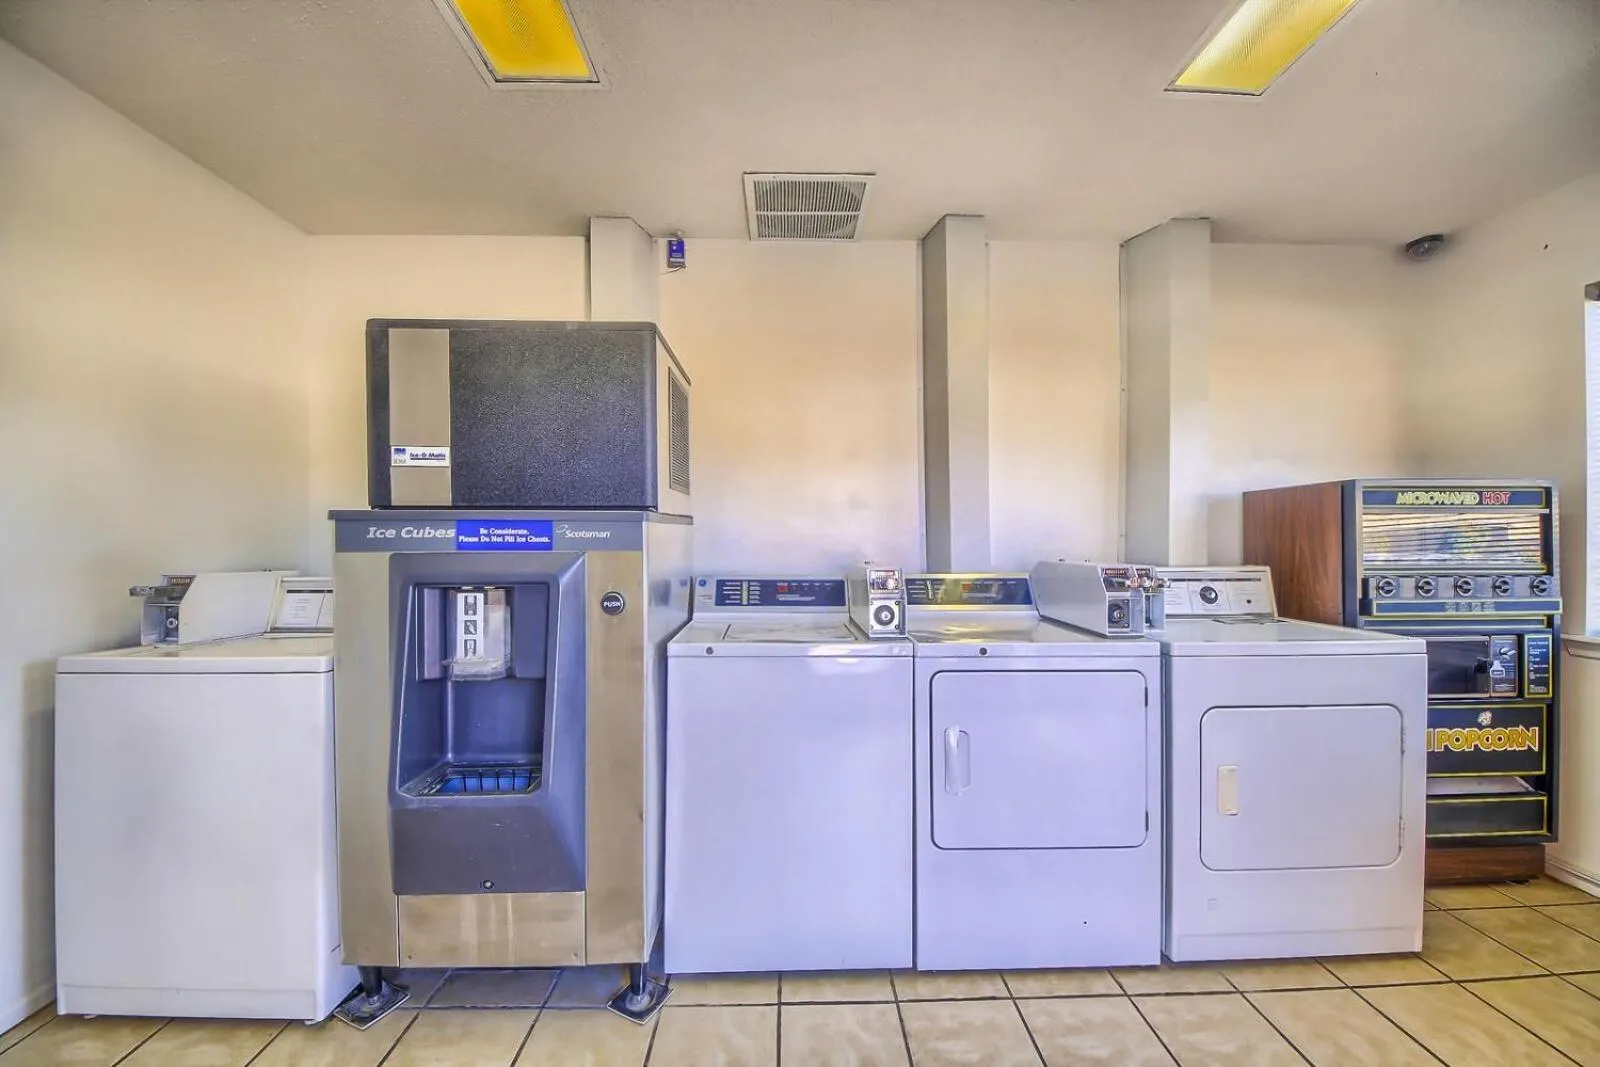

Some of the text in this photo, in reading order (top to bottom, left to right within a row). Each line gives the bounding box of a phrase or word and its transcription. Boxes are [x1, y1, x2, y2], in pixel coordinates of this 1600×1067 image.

[1396, 491, 1511, 505] MICROWAVED HOT
[366, 526, 457, 538] Ice Cubes
[565, 530, 611, 539] Scotsman
[459, 535, 479, 543] Please
[481, 535, 490, 543] Do
[491, 535, 503, 543] Not
[504, 535, 515, 543] Fill
[1435, 725, 1539, 752] POPCORN
